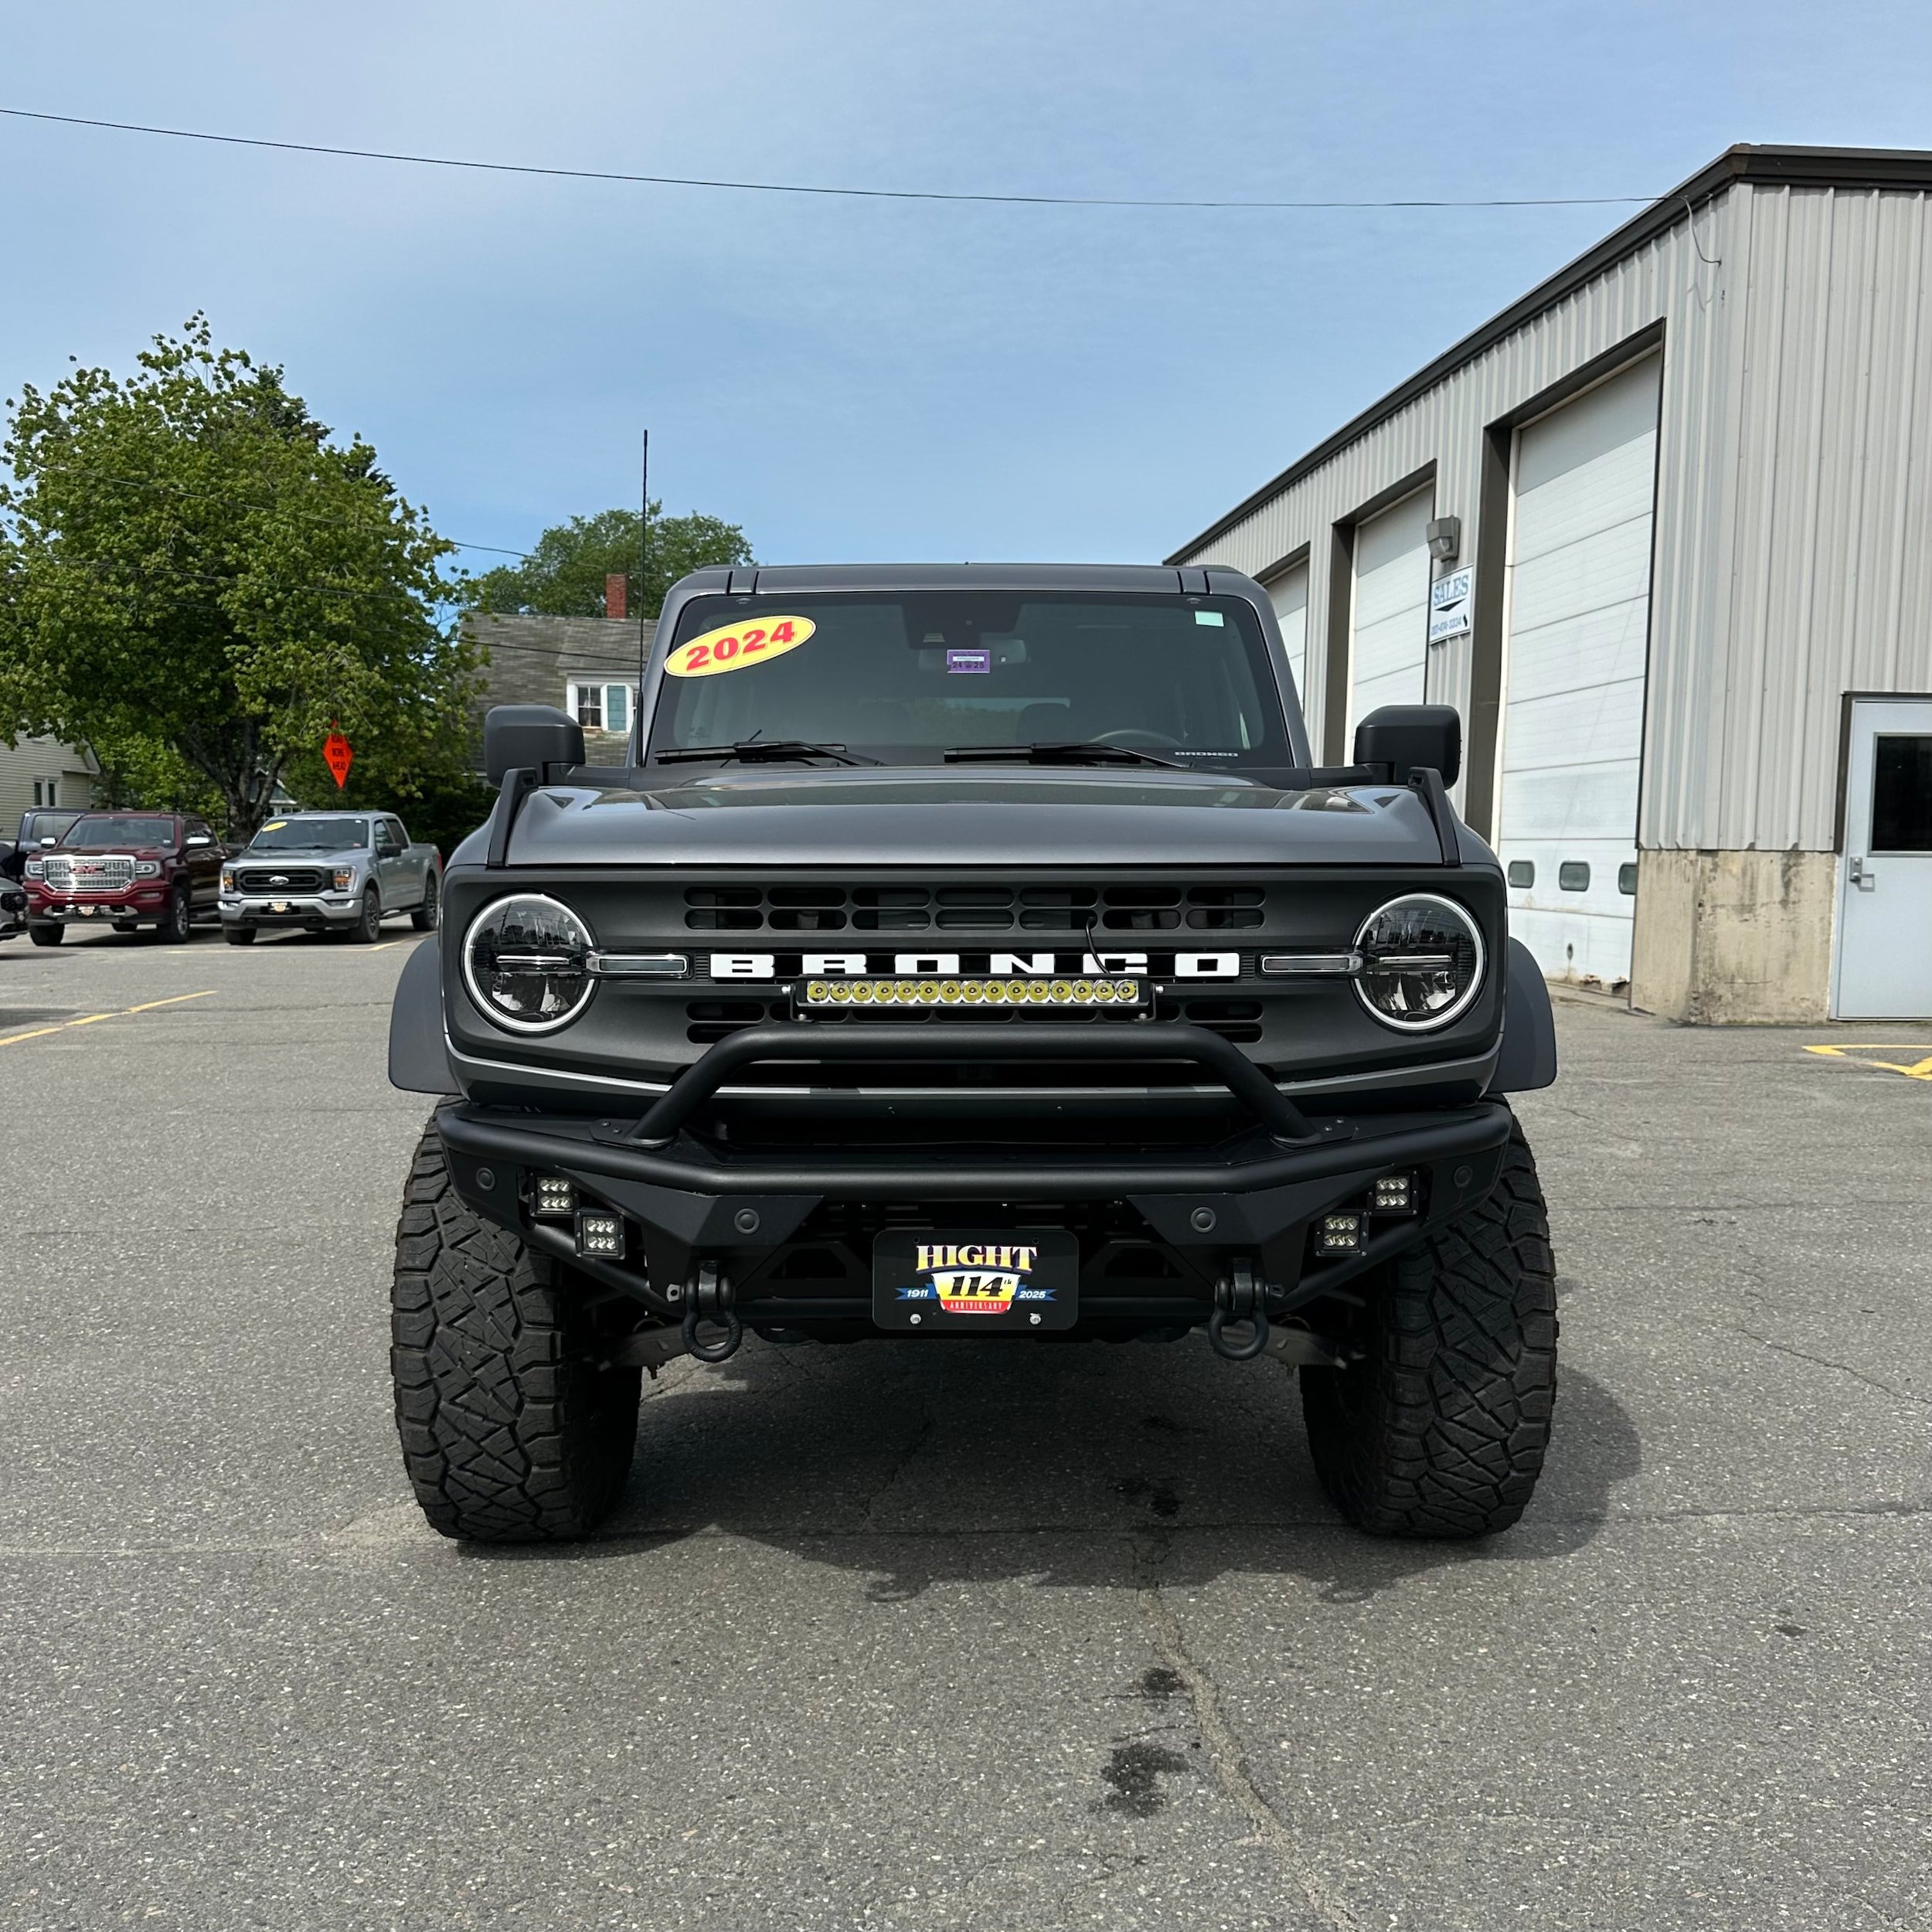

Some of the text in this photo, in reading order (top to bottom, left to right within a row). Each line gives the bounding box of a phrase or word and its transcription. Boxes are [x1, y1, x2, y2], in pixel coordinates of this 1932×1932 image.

[1434, 574, 1469, 607] SALES
[685, 620, 796, 671] 2024
[332, 747, 345, 757] WORK
[332, 761, 346, 770] AHEAD
[72, 865, 104, 874] GMC
[709, 953, 1240, 978] BRONCO
[915, 1244, 1038, 1274] HIGHT
[906, 1289, 929, 1298] 1911
[1019, 1290, 1046, 1299] 2025
[950, 1301, 1003, 1311] ANNIVERSARY
